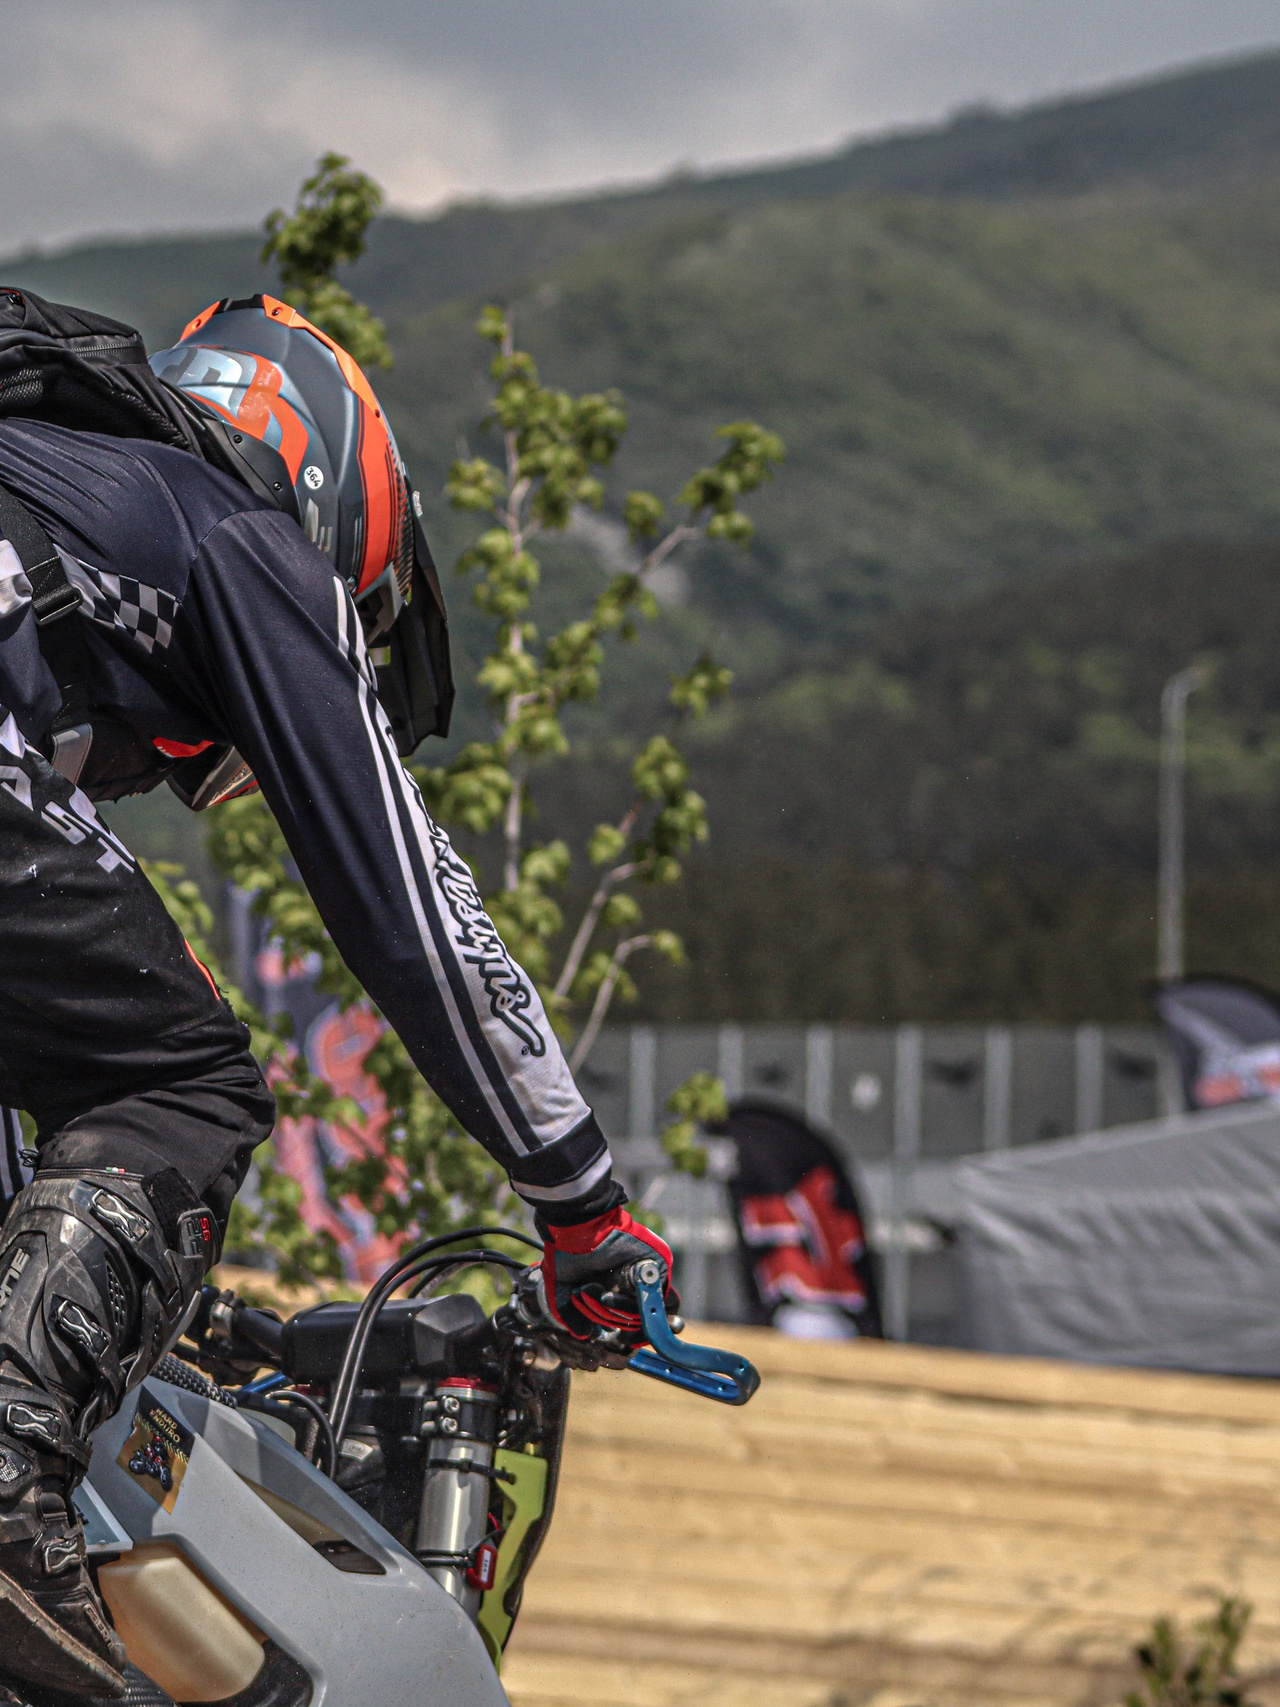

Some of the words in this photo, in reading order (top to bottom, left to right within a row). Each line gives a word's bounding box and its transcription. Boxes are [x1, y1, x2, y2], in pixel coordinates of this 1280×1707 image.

[306, 466, 321, 487] 364
[149, 1408, 181, 1443] ENDURO
[155, 1408, 178, 1430] HARD
